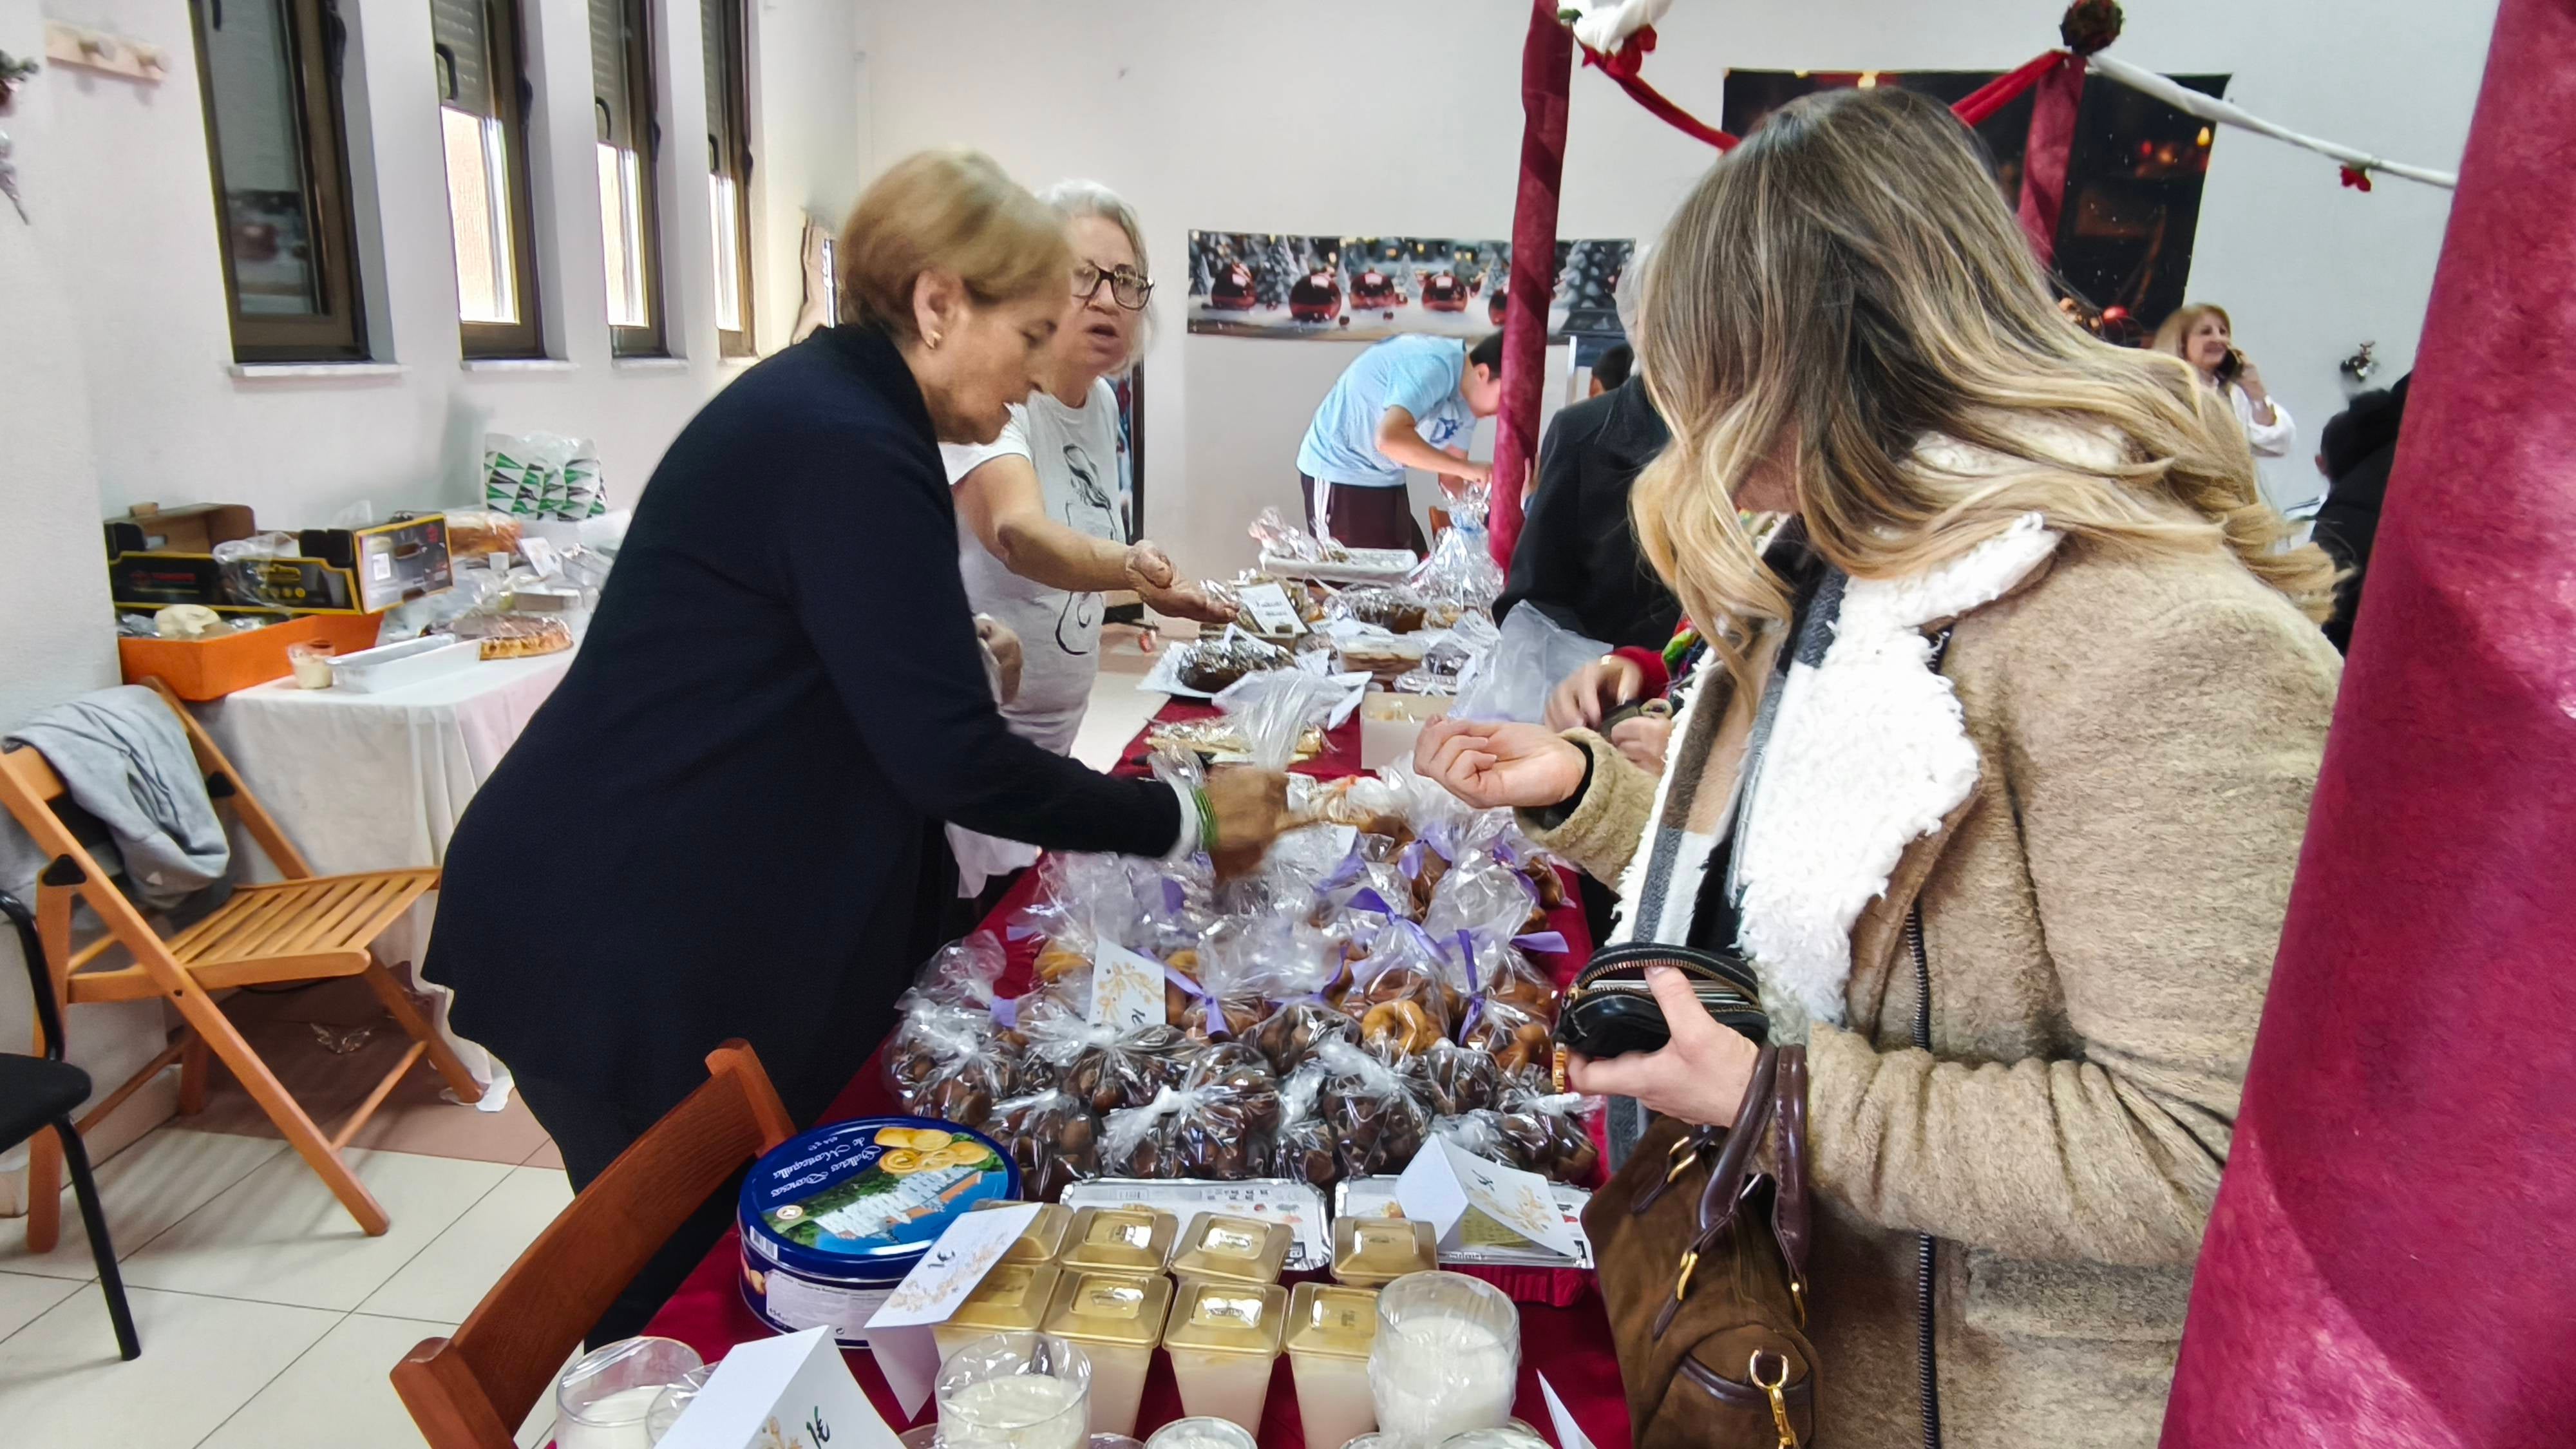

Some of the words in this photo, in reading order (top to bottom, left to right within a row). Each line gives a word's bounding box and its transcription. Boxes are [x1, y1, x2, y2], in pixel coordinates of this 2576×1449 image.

[852, 1137, 865, 1147] de
[773, 1144, 851, 1180] Mantequilla
[830, 1145, 882, 1172] Galletas
[771, 1171, 829, 1198] Danesas
